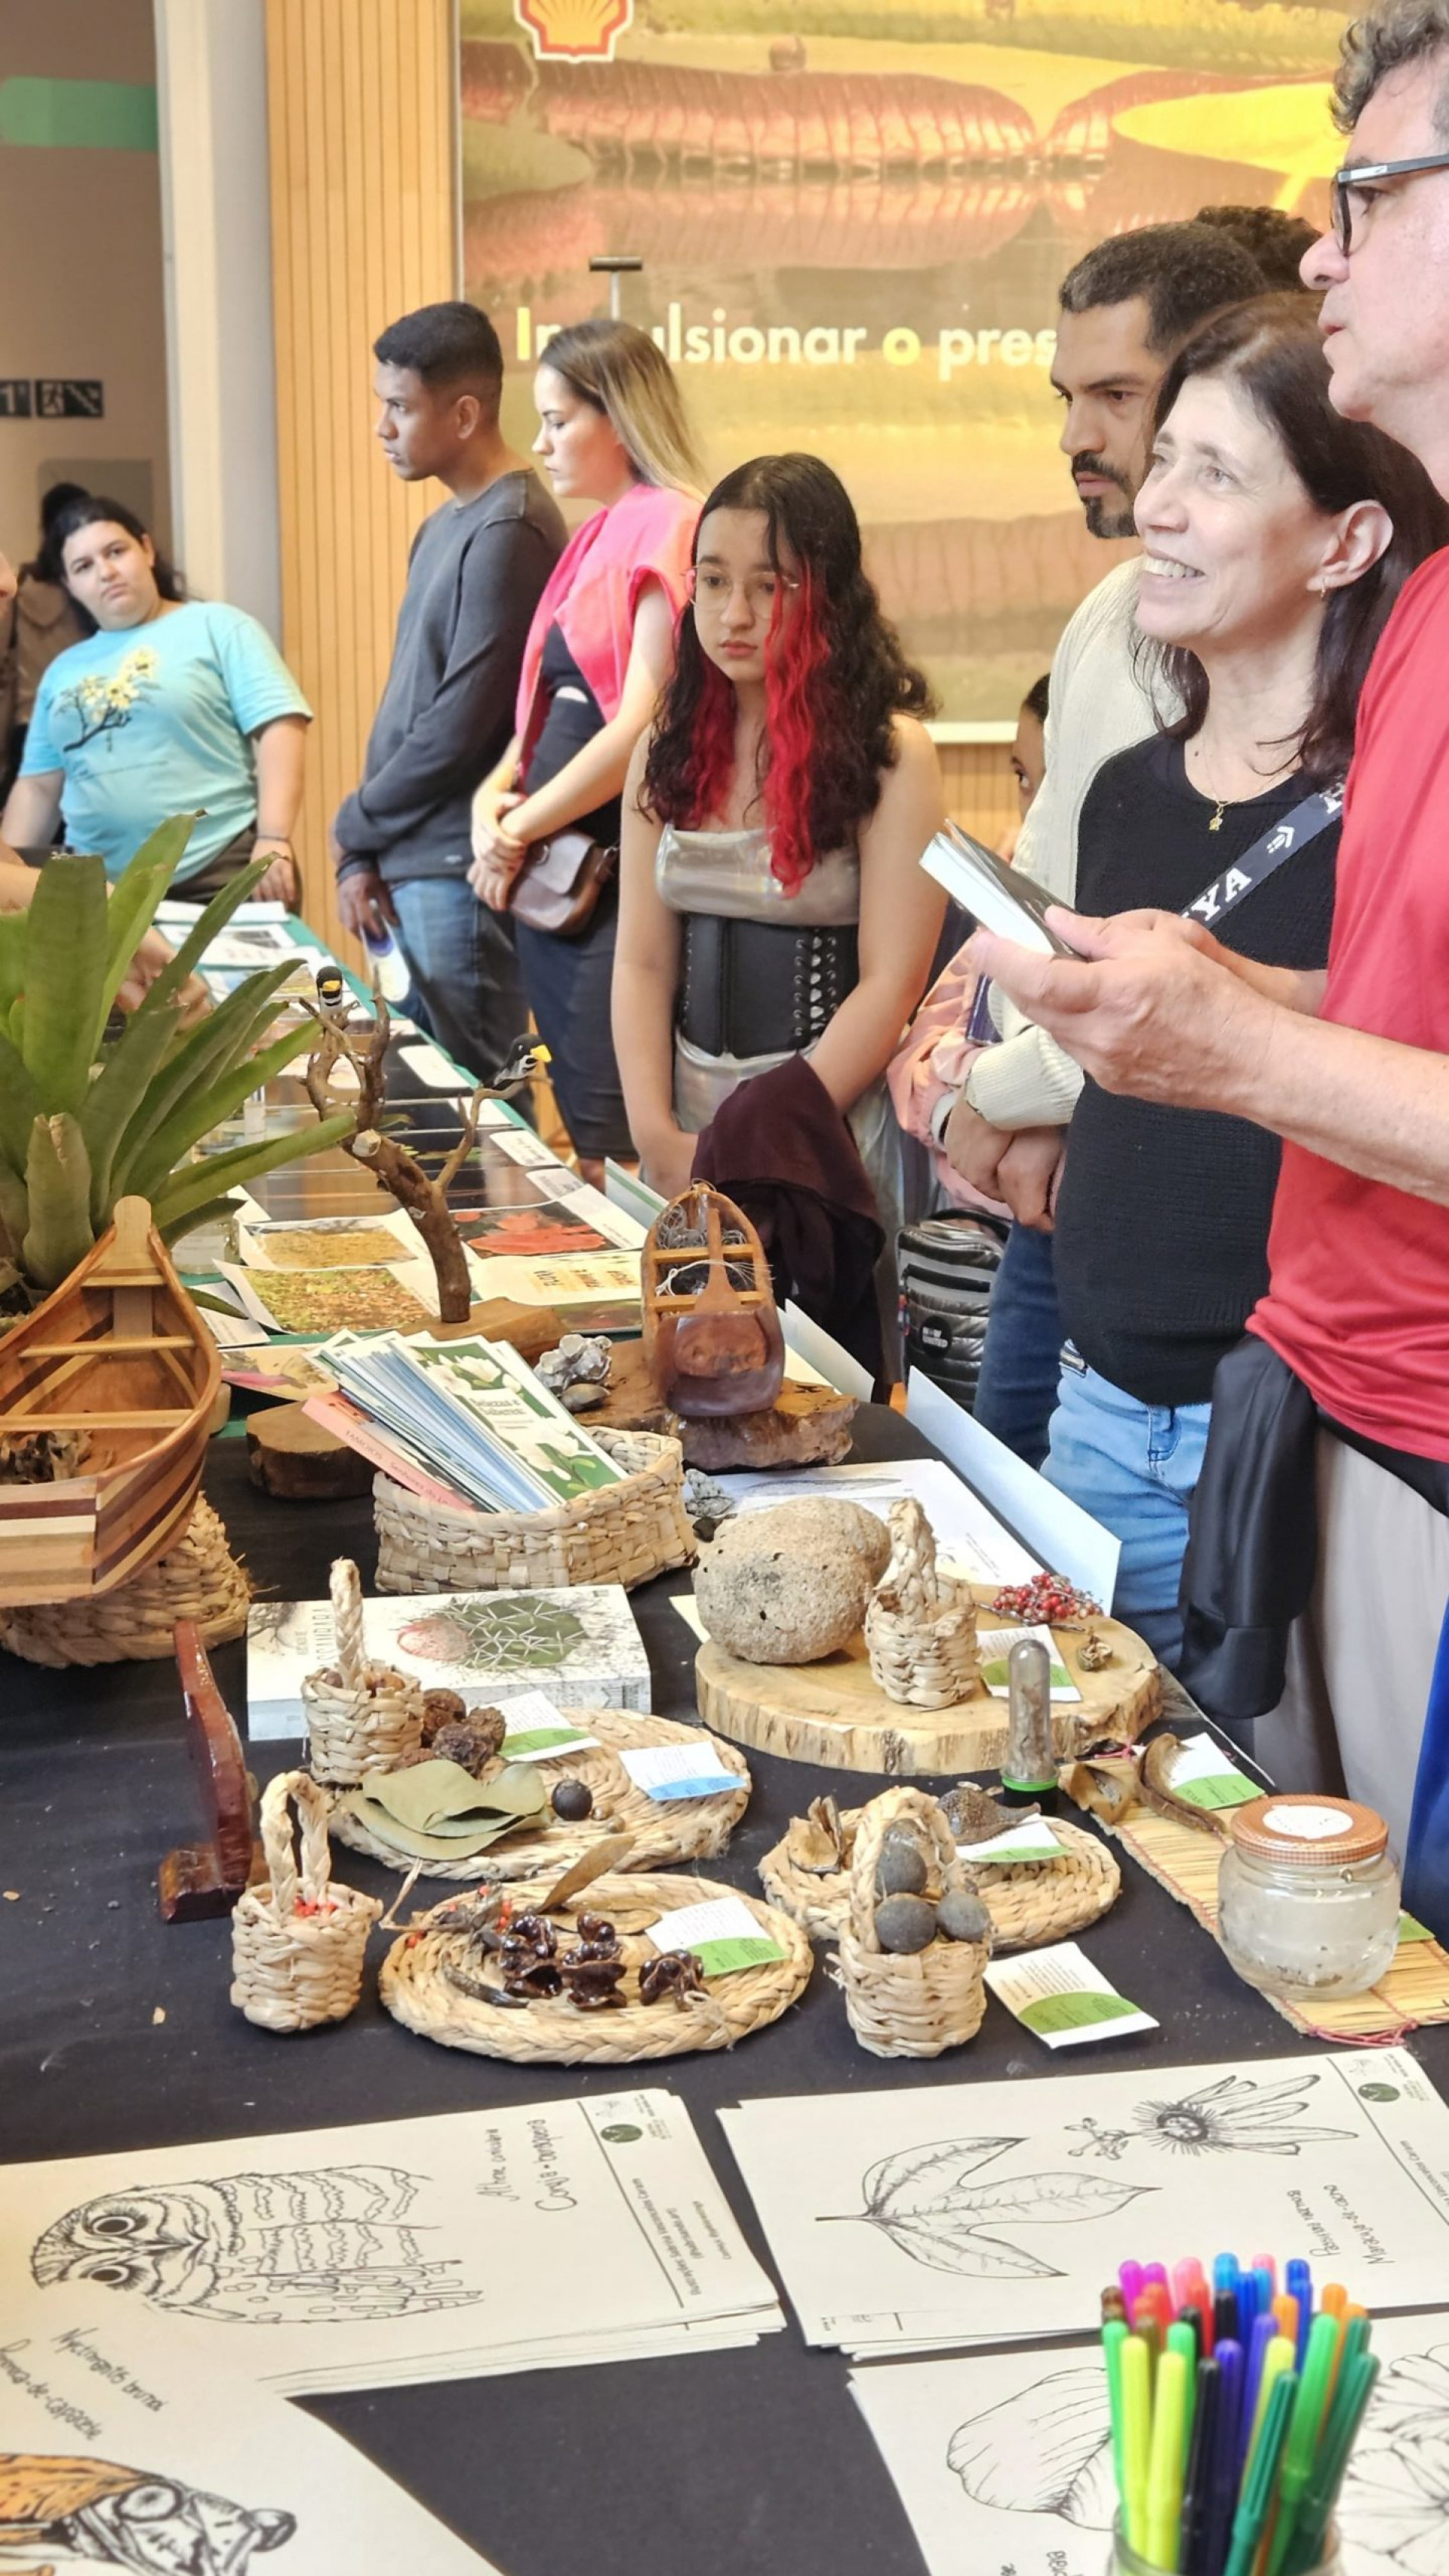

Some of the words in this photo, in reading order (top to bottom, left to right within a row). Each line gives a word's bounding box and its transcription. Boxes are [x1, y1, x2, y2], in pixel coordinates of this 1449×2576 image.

[517, 303, 866, 365] Iulsionar
[882, 327, 921, 366] o
[1182, 867, 1253, 922] YA
